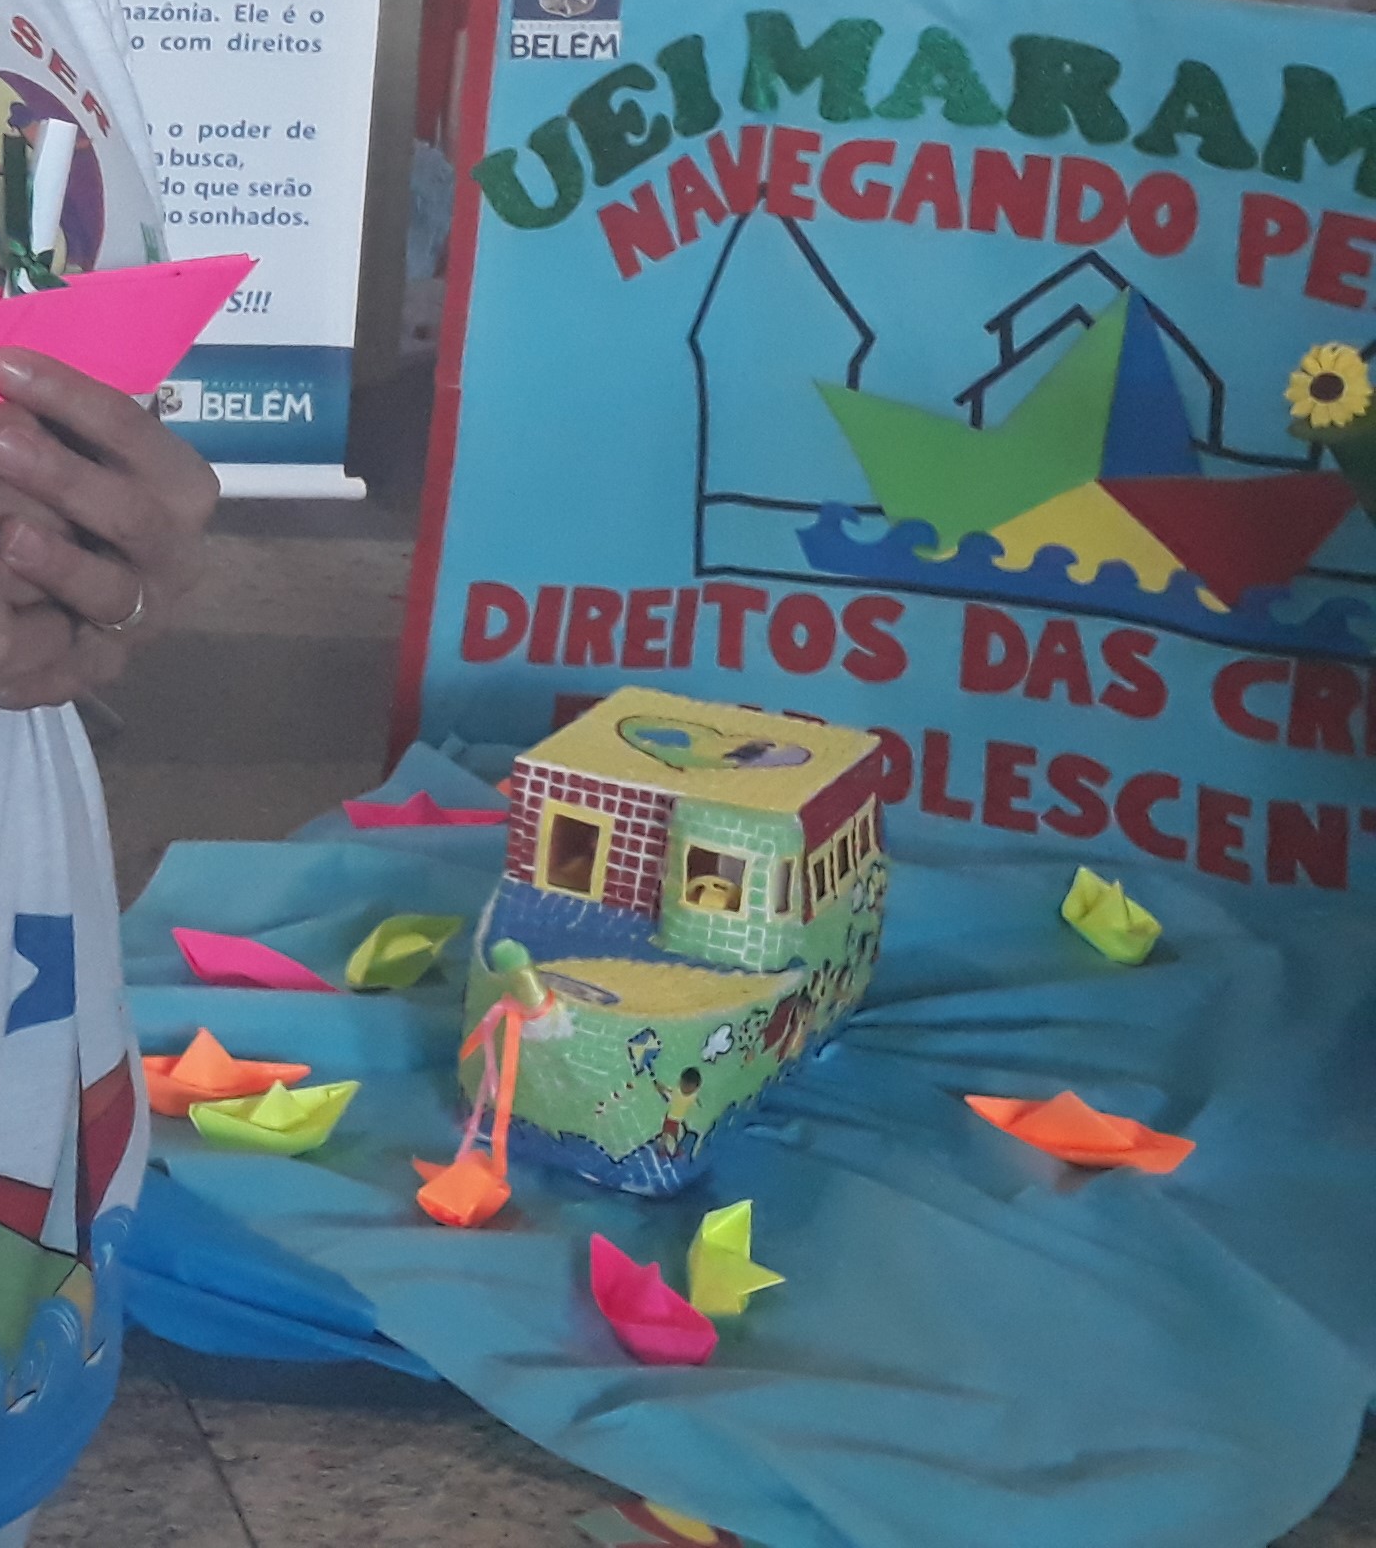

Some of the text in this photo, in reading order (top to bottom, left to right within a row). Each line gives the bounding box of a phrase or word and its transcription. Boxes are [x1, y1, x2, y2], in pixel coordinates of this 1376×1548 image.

[234, 4, 269, 23] Ele
[282, 4, 296, 24] é
[309, 10, 325, 24] o
[160, 35, 211, 51] com
[227, 33, 322, 53] direitos
[10, 14, 112, 138] SER
[169, 124, 183, 139] o
[198, 119, 272, 143] poder
[286, 121, 316, 140] de
[470, 34, 723, 231] UEI
[169, 149, 245, 170] busca,
[194, 181, 239, 202] que
[248, 176, 312, 198] serão
[188, 205, 310, 226] sonhados.
[597, 125, 1199, 281] NAVEGANDO
[459, 581, 909, 682] DIREITOS
[960, 606, 1170, 719] DAS
